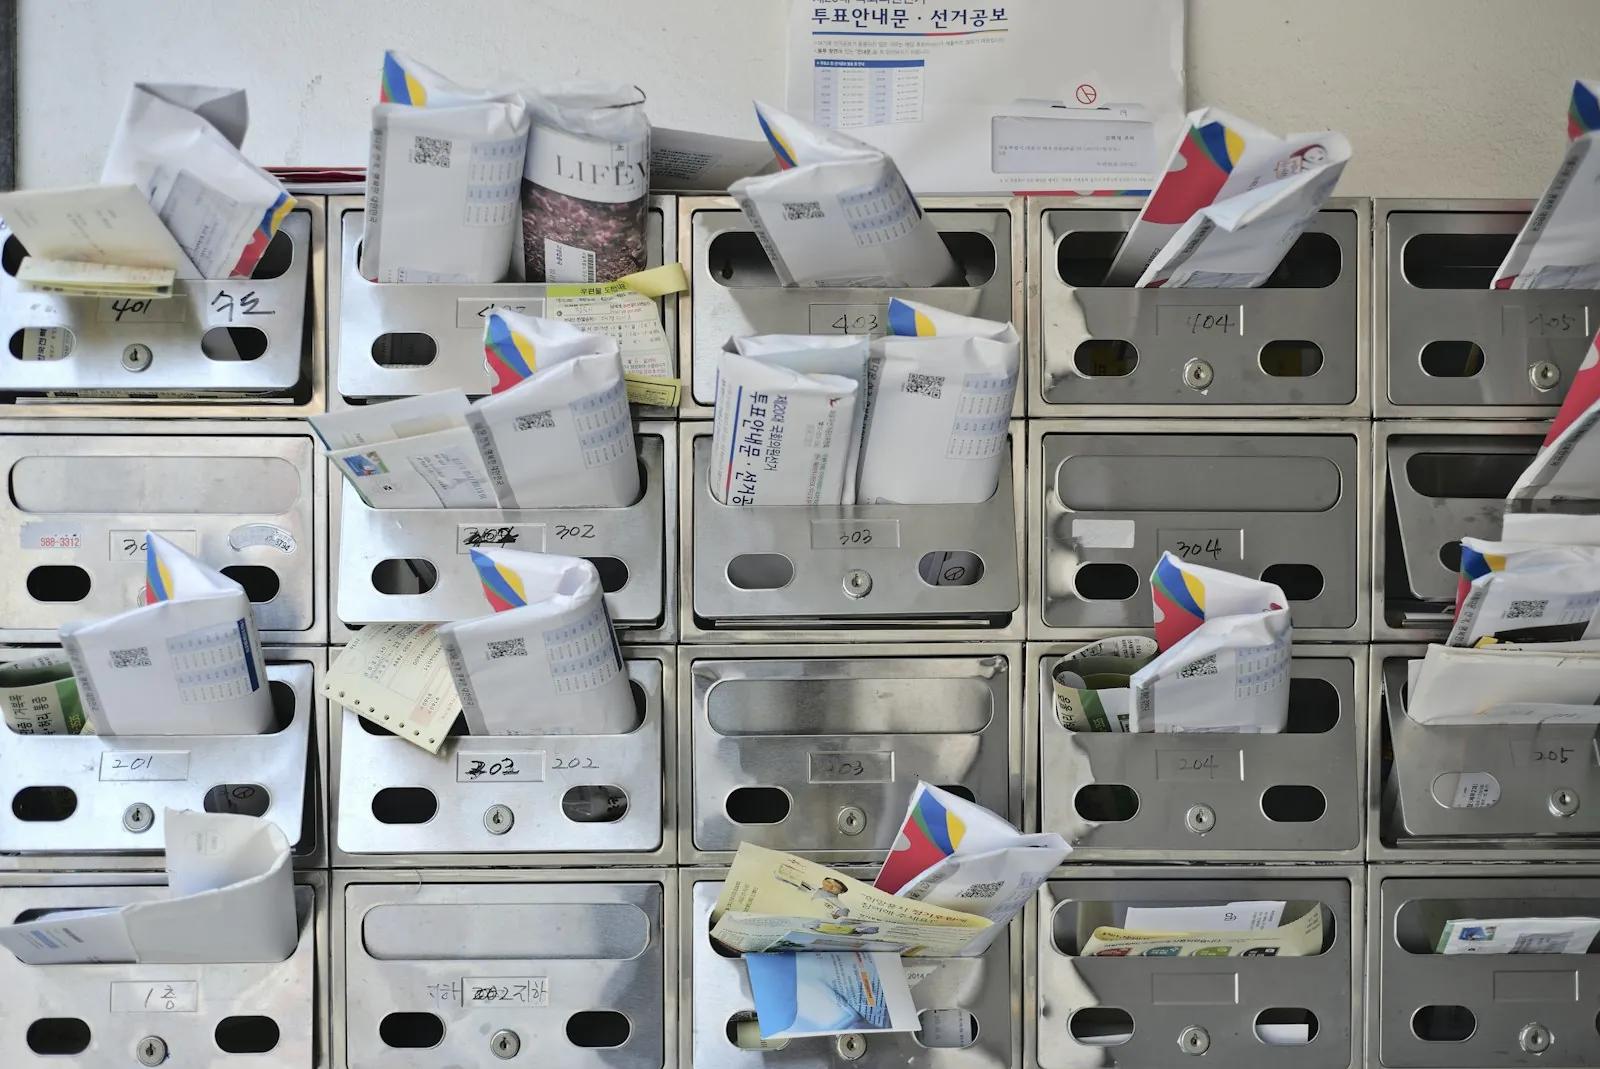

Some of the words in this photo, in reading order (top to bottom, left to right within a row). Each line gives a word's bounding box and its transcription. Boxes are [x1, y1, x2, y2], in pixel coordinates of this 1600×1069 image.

[811, 8, 909, 28] 투표안내문
[931, 8, 1009, 29] 선거공보
[112, 298, 152, 322] 401
[739, 391, 768, 457] 투표안내문
[555, 524, 596, 540] 302
[123, 538, 148, 556] 30
[1176, 538, 1223, 561] 304
[111, 755, 153, 770] 201
[551, 757, 600, 769] 202
